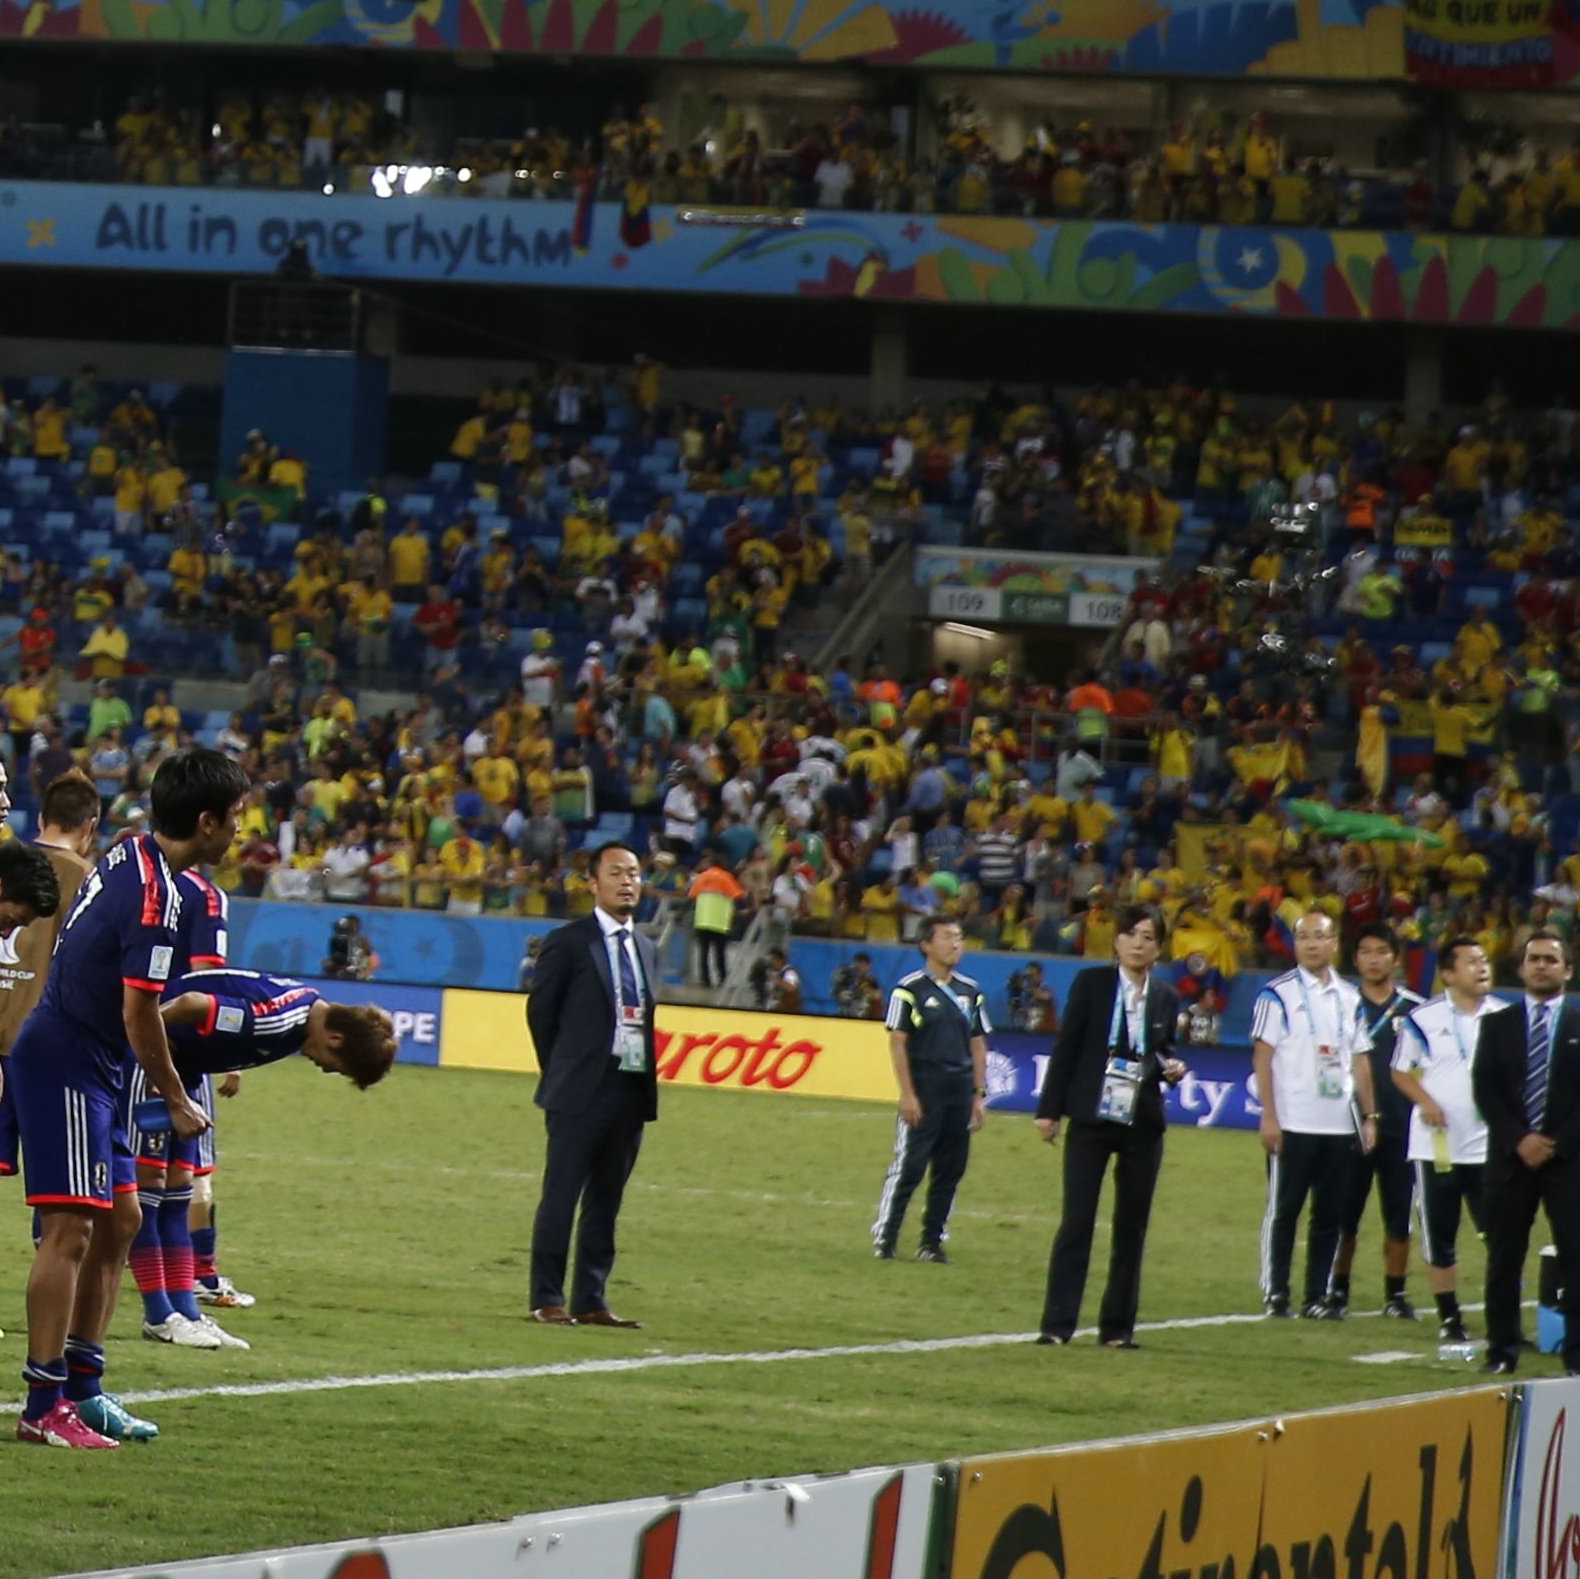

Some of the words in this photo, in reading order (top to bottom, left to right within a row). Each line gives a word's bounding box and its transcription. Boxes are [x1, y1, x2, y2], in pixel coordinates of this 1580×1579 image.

[96, 203, 167, 251] All
[187, 205, 237, 256] in
[258, 215, 362, 261] one
